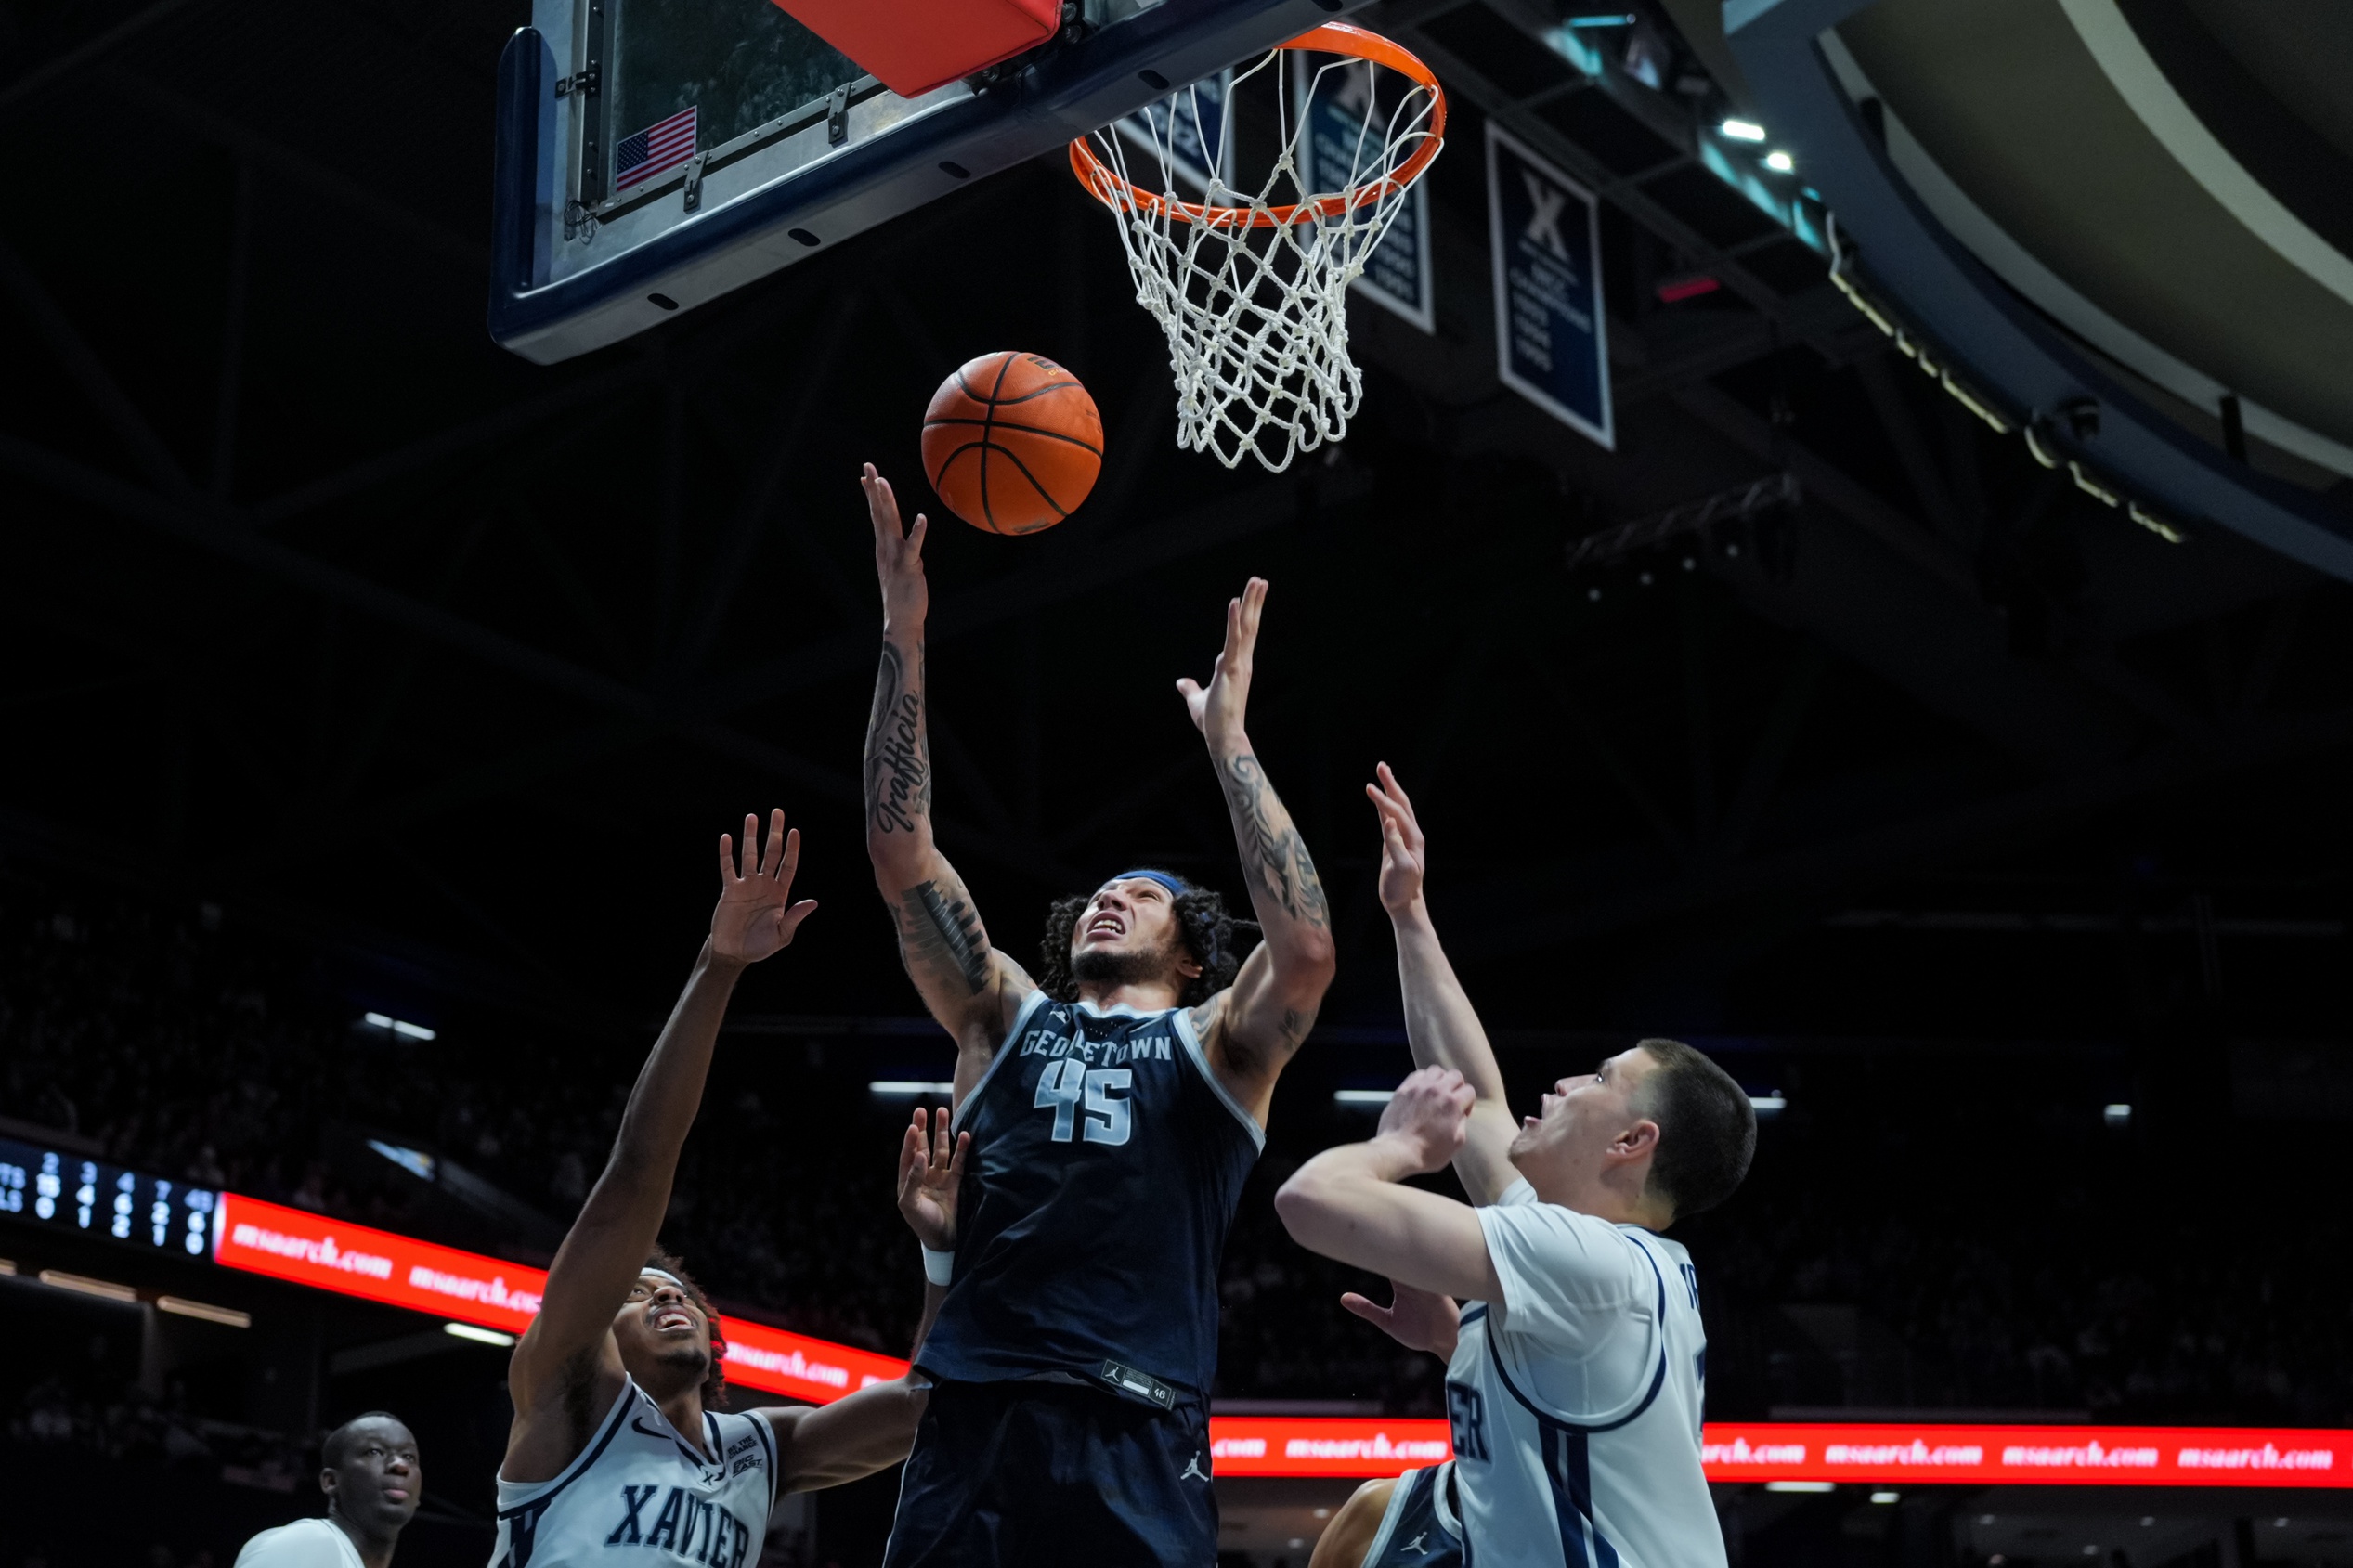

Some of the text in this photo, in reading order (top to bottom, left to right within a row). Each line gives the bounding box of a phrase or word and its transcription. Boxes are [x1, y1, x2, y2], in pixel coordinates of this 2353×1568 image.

[1519, 166, 1571, 265] X
[1019, 1029, 1172, 1067] GEOETOWN
[1033, 1057, 1132, 1147] 45
[42, 1152, 60, 1174] 2
[80, 1161, 98, 1185] 3
[116, 1172, 136, 1193] 4
[155, 1179, 172, 1201] 7
[35, 1196, 55, 1220] 0
[78, 1205, 91, 1229] 1
[111, 1213, 131, 1238] 2
[152, 1224, 166, 1247] 1
[185, 1232, 204, 1255] 0
[76, 1184, 96, 1206] 4
[114, 1192, 133, 1215] 6
[151, 1201, 170, 1225] 2
[188, 1211, 206, 1233] 6
[232, 1223, 544, 1315] msaarch.com msaarch.co
[1153, 1387, 1166, 1400] 46
[728, 1440, 759, 1460] CHANGE
[737, 1434, 753, 1446] THE
[1285, 1432, 1448, 1459] msaarch.com
[1701, 1437, 2334, 1470] arch.com msaarch.com msaarch.com msaarch.com
[733, 1458, 763, 1475] EAST
[734, 1454, 754, 1468] BIG
[604, 1484, 750, 1568] XAVIER
